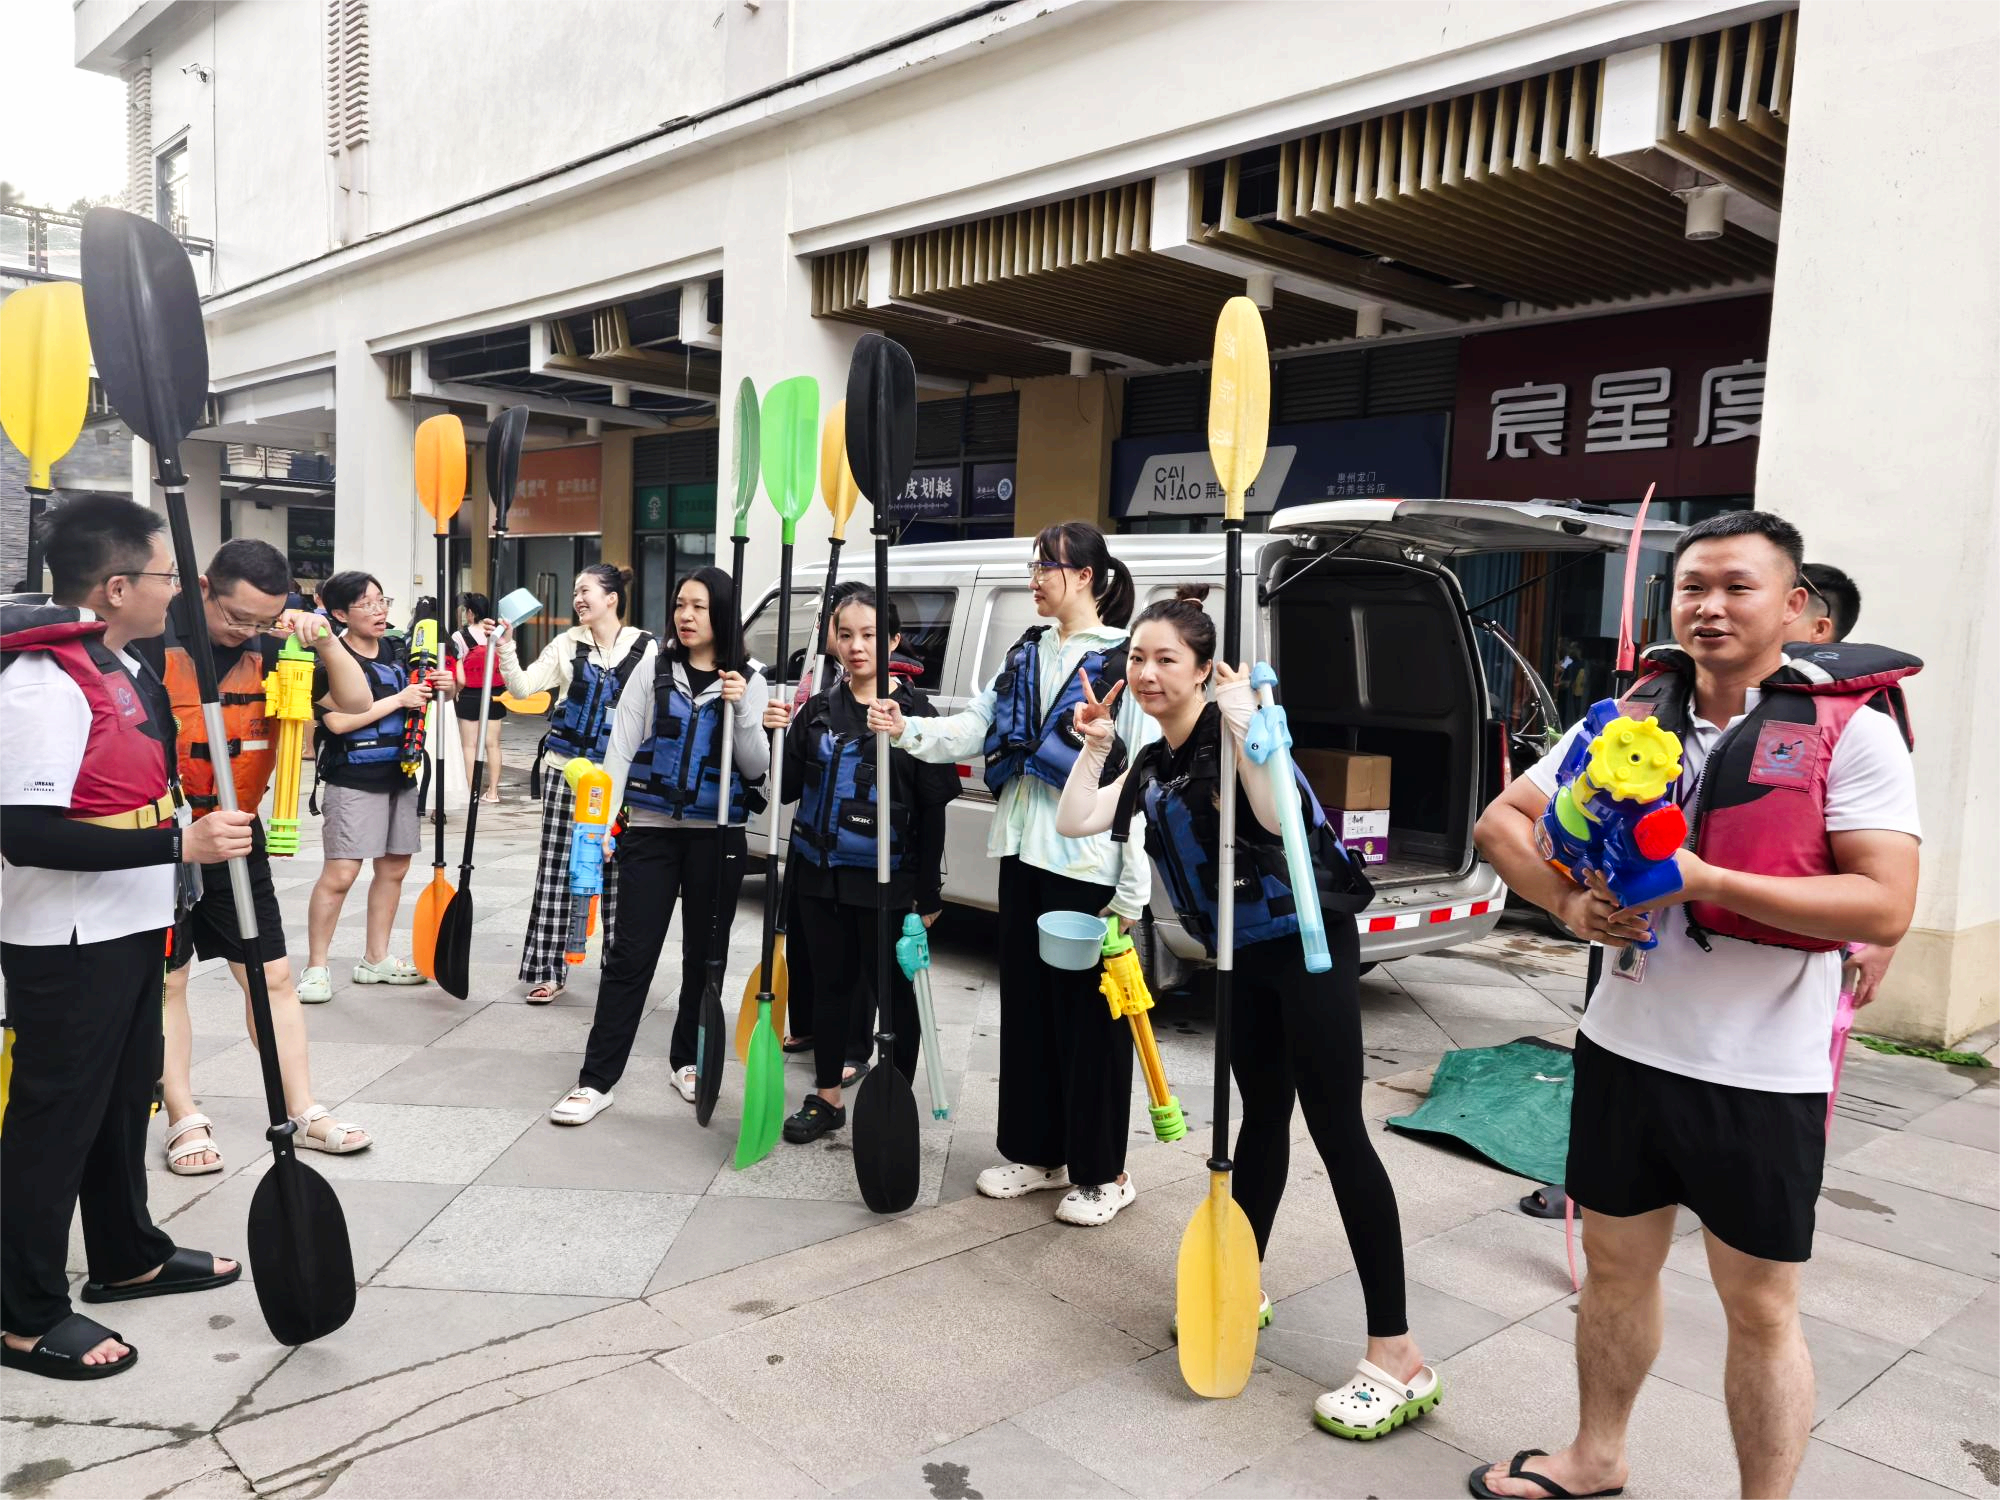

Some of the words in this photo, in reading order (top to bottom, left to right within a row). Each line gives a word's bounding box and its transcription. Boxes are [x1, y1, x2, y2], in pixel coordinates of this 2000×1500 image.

[1487, 359, 1766, 460] 宸星度
[897, 477, 953, 500] 皮划艇
